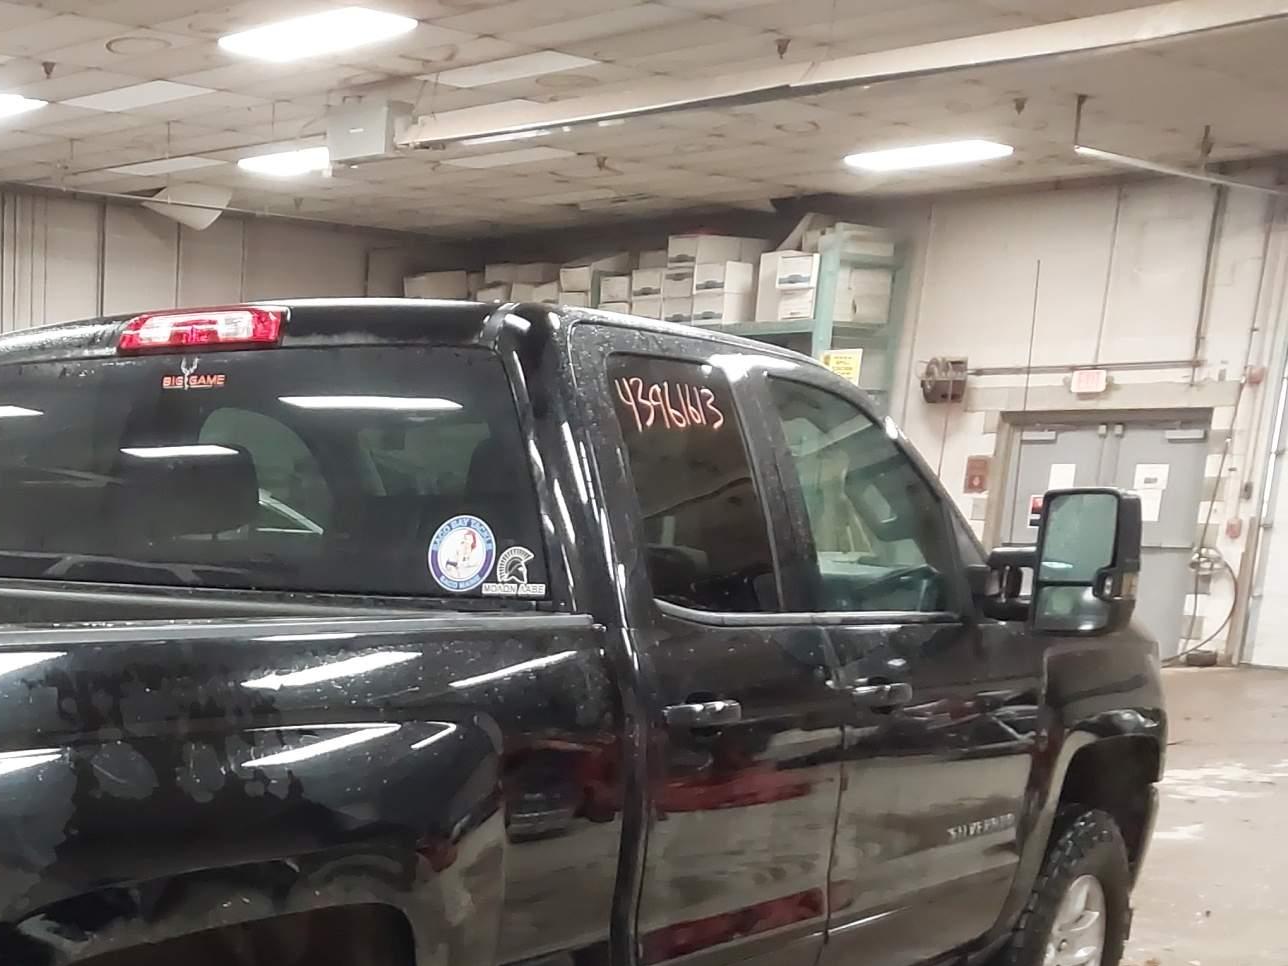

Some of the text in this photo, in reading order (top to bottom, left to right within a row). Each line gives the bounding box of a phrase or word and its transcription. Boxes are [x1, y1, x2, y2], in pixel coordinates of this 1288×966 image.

[162, 374, 226, 387] BIG GAME
[614, 377, 725, 432] 43961613
